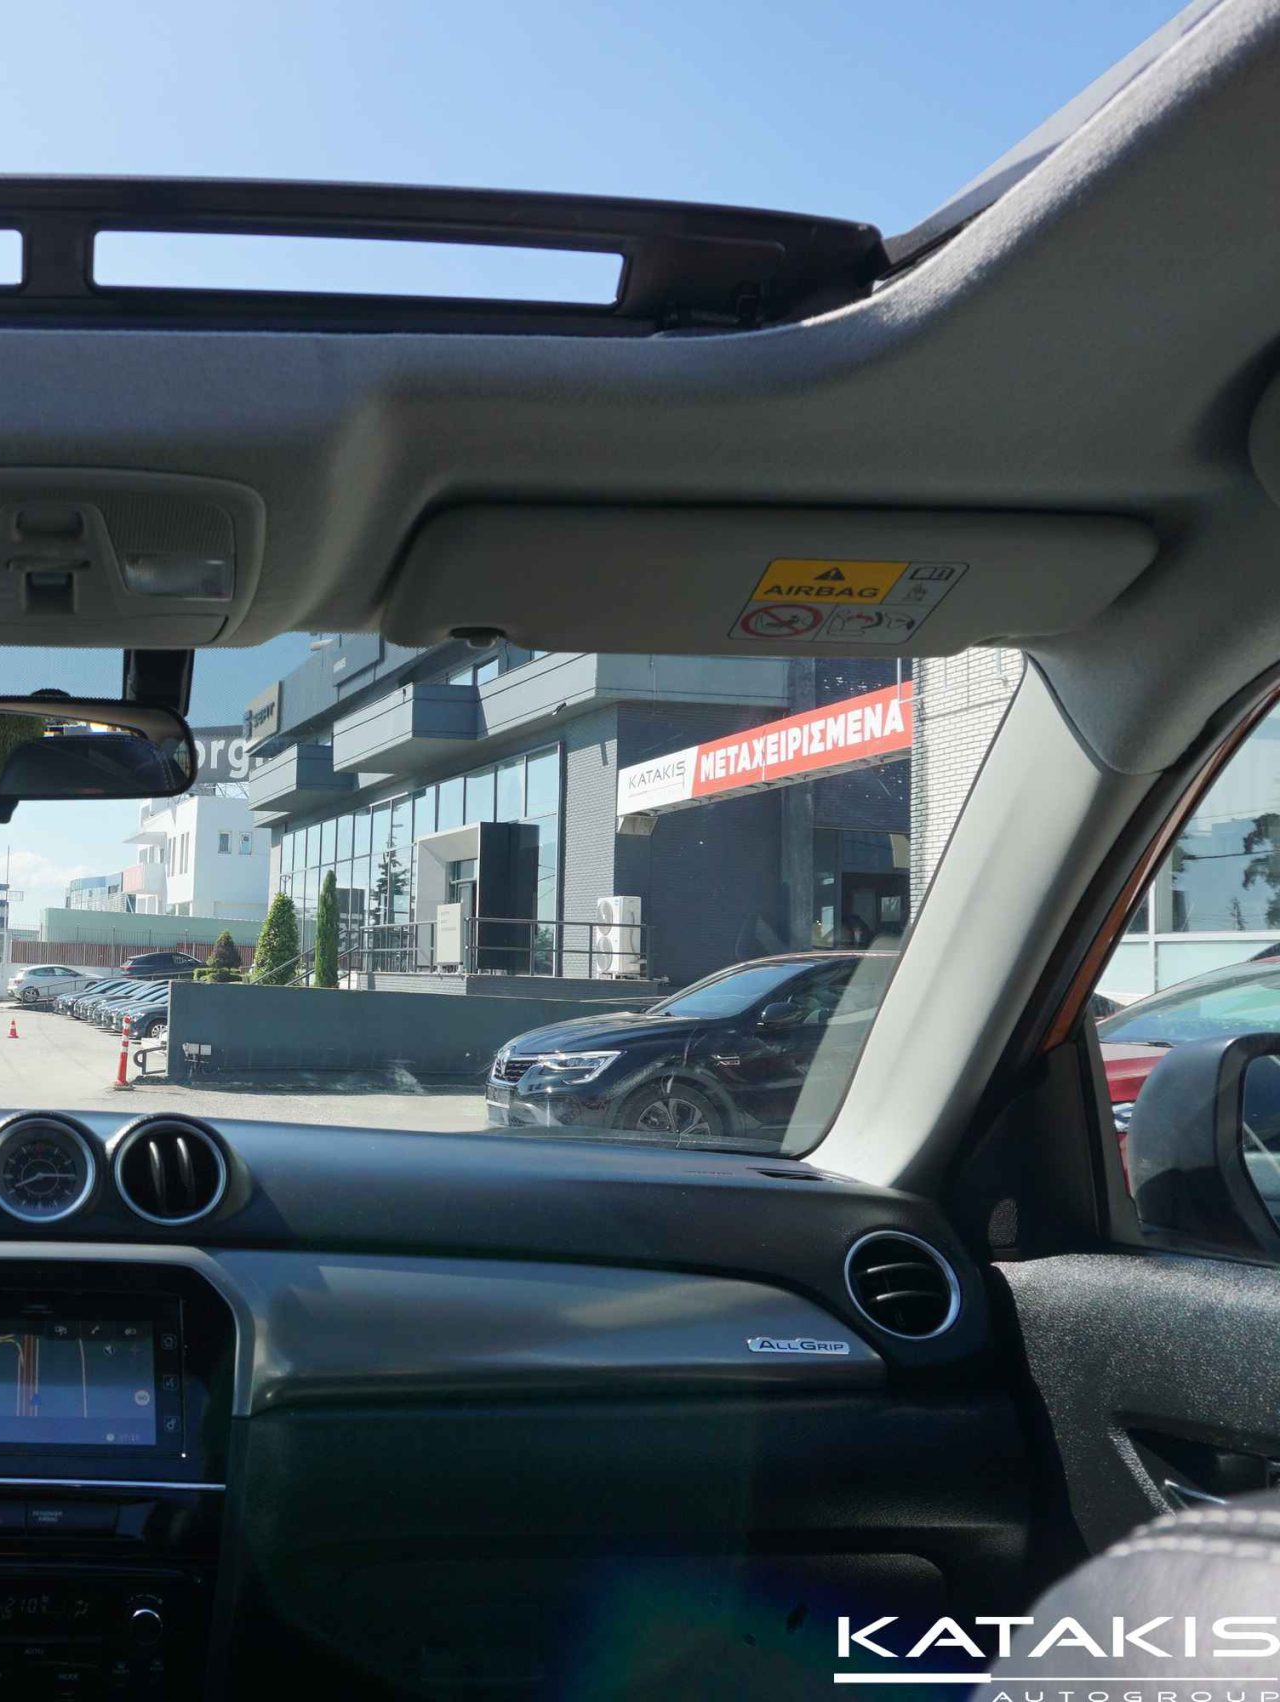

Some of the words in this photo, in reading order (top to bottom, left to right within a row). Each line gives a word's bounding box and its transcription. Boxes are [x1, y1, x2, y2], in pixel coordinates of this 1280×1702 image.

[764, 585, 880, 599] AIRBAG
[700, 699, 905, 783] ΜΕΤΑΧΕΙΡΙΣΜΕΝΑ
[628, 760, 687, 790] KATAKIS
